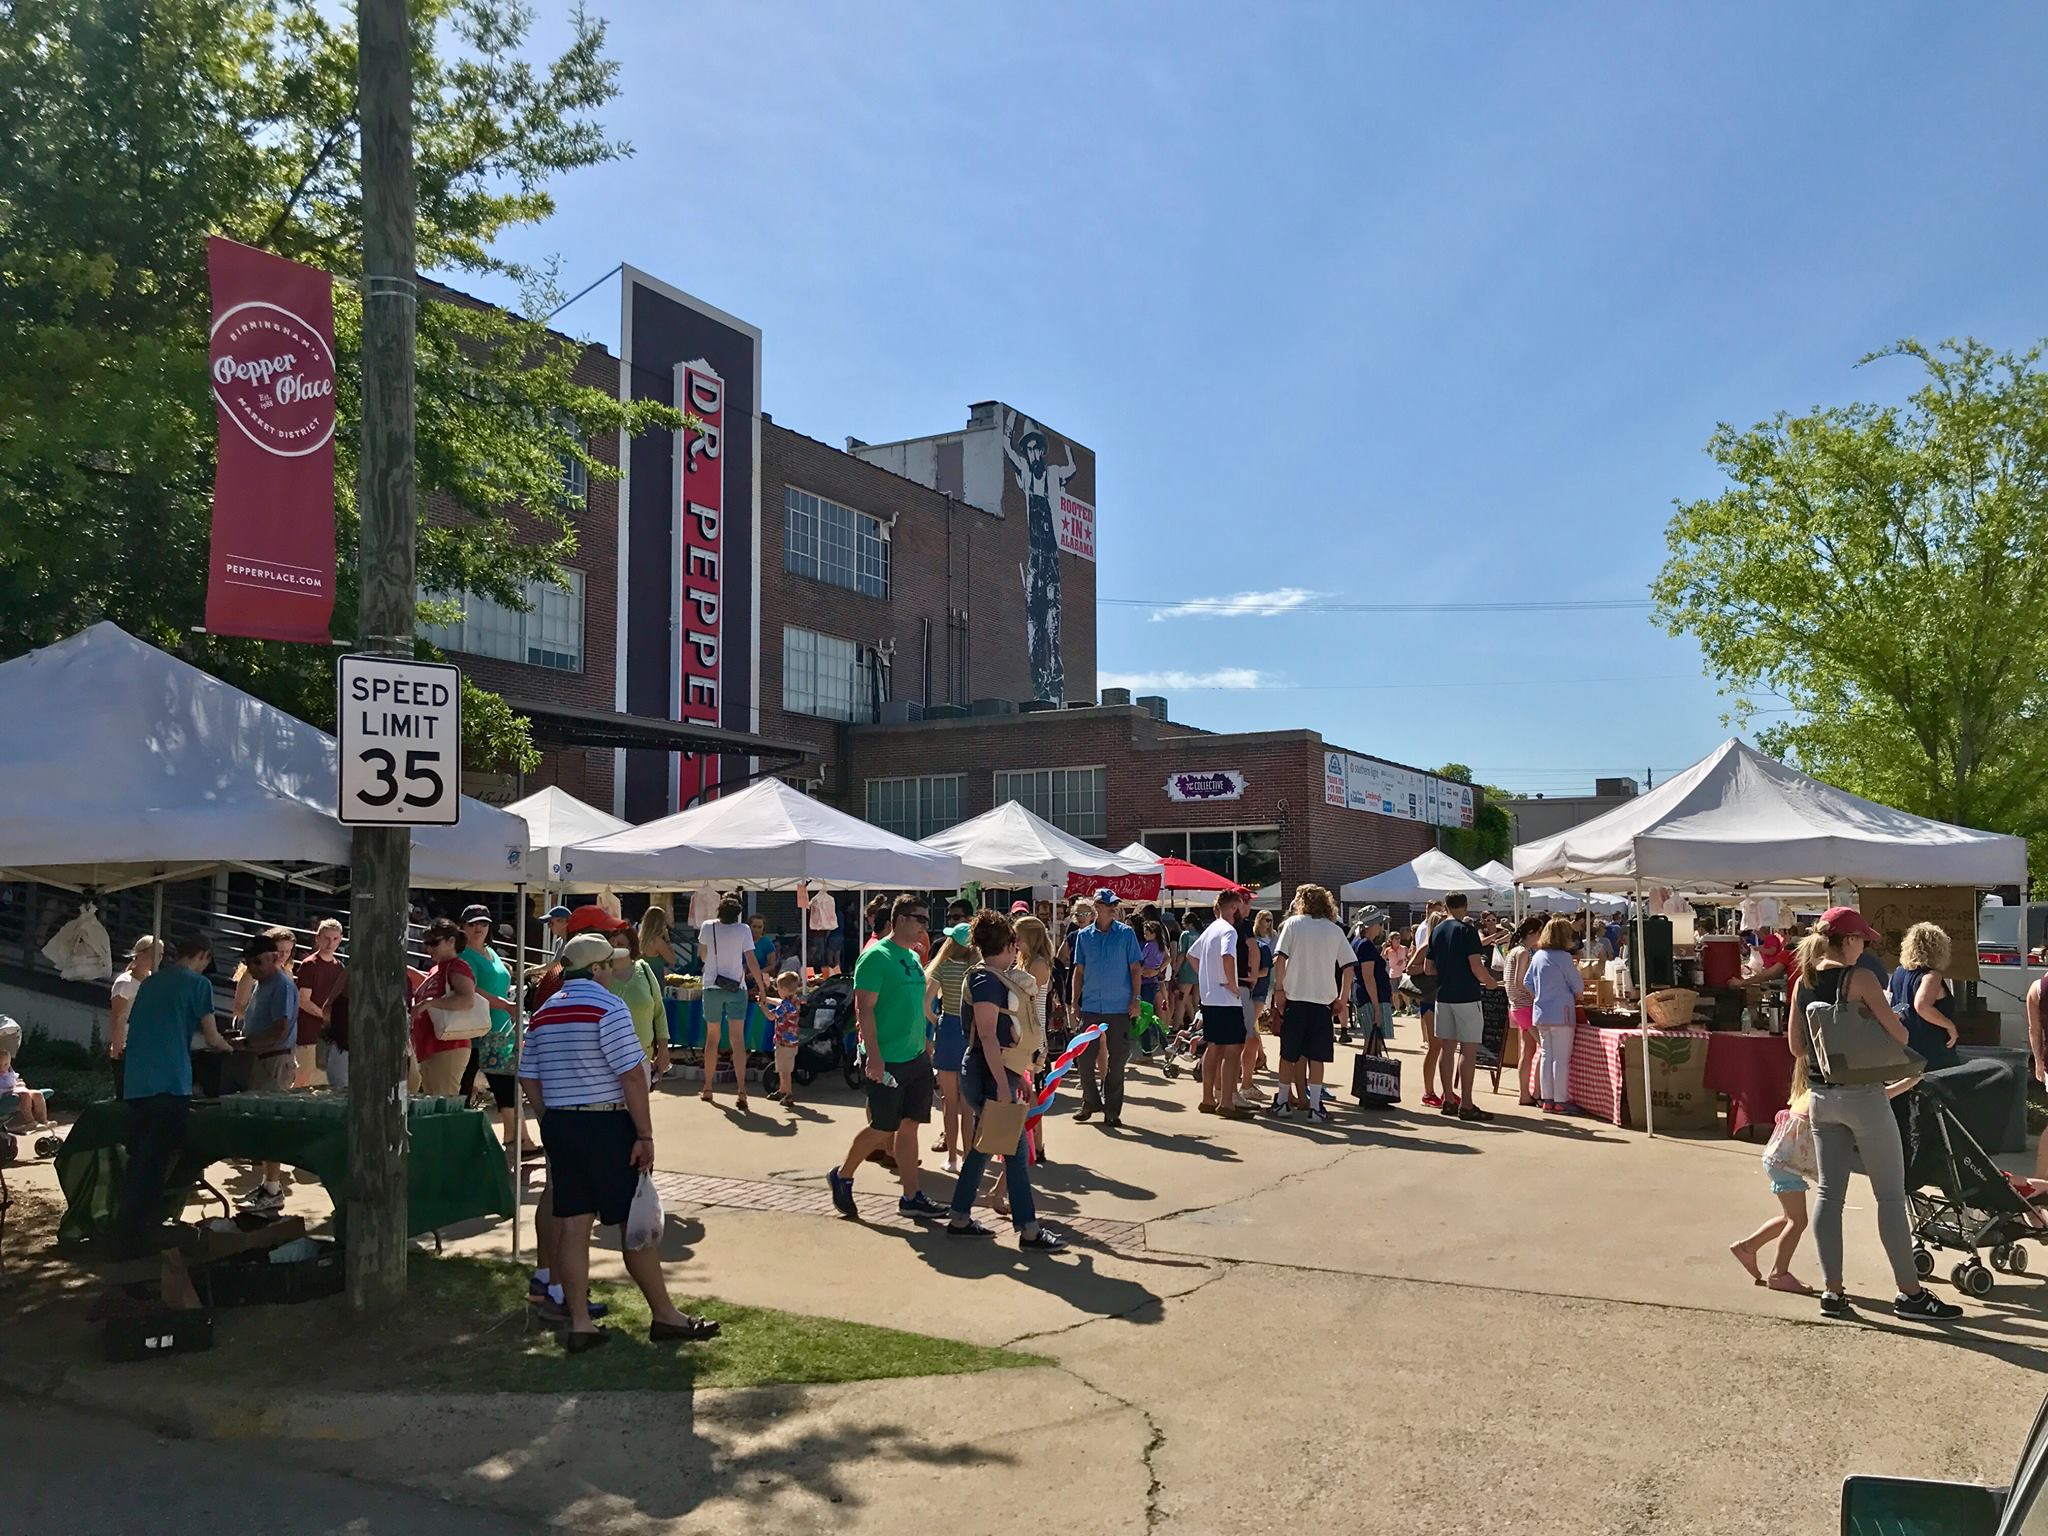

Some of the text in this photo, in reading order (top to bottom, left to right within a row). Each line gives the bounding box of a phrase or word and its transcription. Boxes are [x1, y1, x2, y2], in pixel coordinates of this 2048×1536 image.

[230, 320, 320, 361] BIRMINGHAM'S
[213, 353, 297, 387] Pepper
[275, 373, 333, 405] Place
[238, 397, 321, 439] MARKET DISTRICT
[687, 371, 720, 473] DR.
[1060, 496, 1093, 523] ROOTED
[1071, 517, 1083, 539] IN
[1060, 534, 1094, 557] ALABAMA
[226, 564, 322, 587] PEPPERPLACE.COM
[351, 676, 449, 707] SPEED
[362, 711, 439, 739] LIMIT
[356, 747, 444, 808] 35
[1194, 780, 1224, 791] COLLECTIVE
